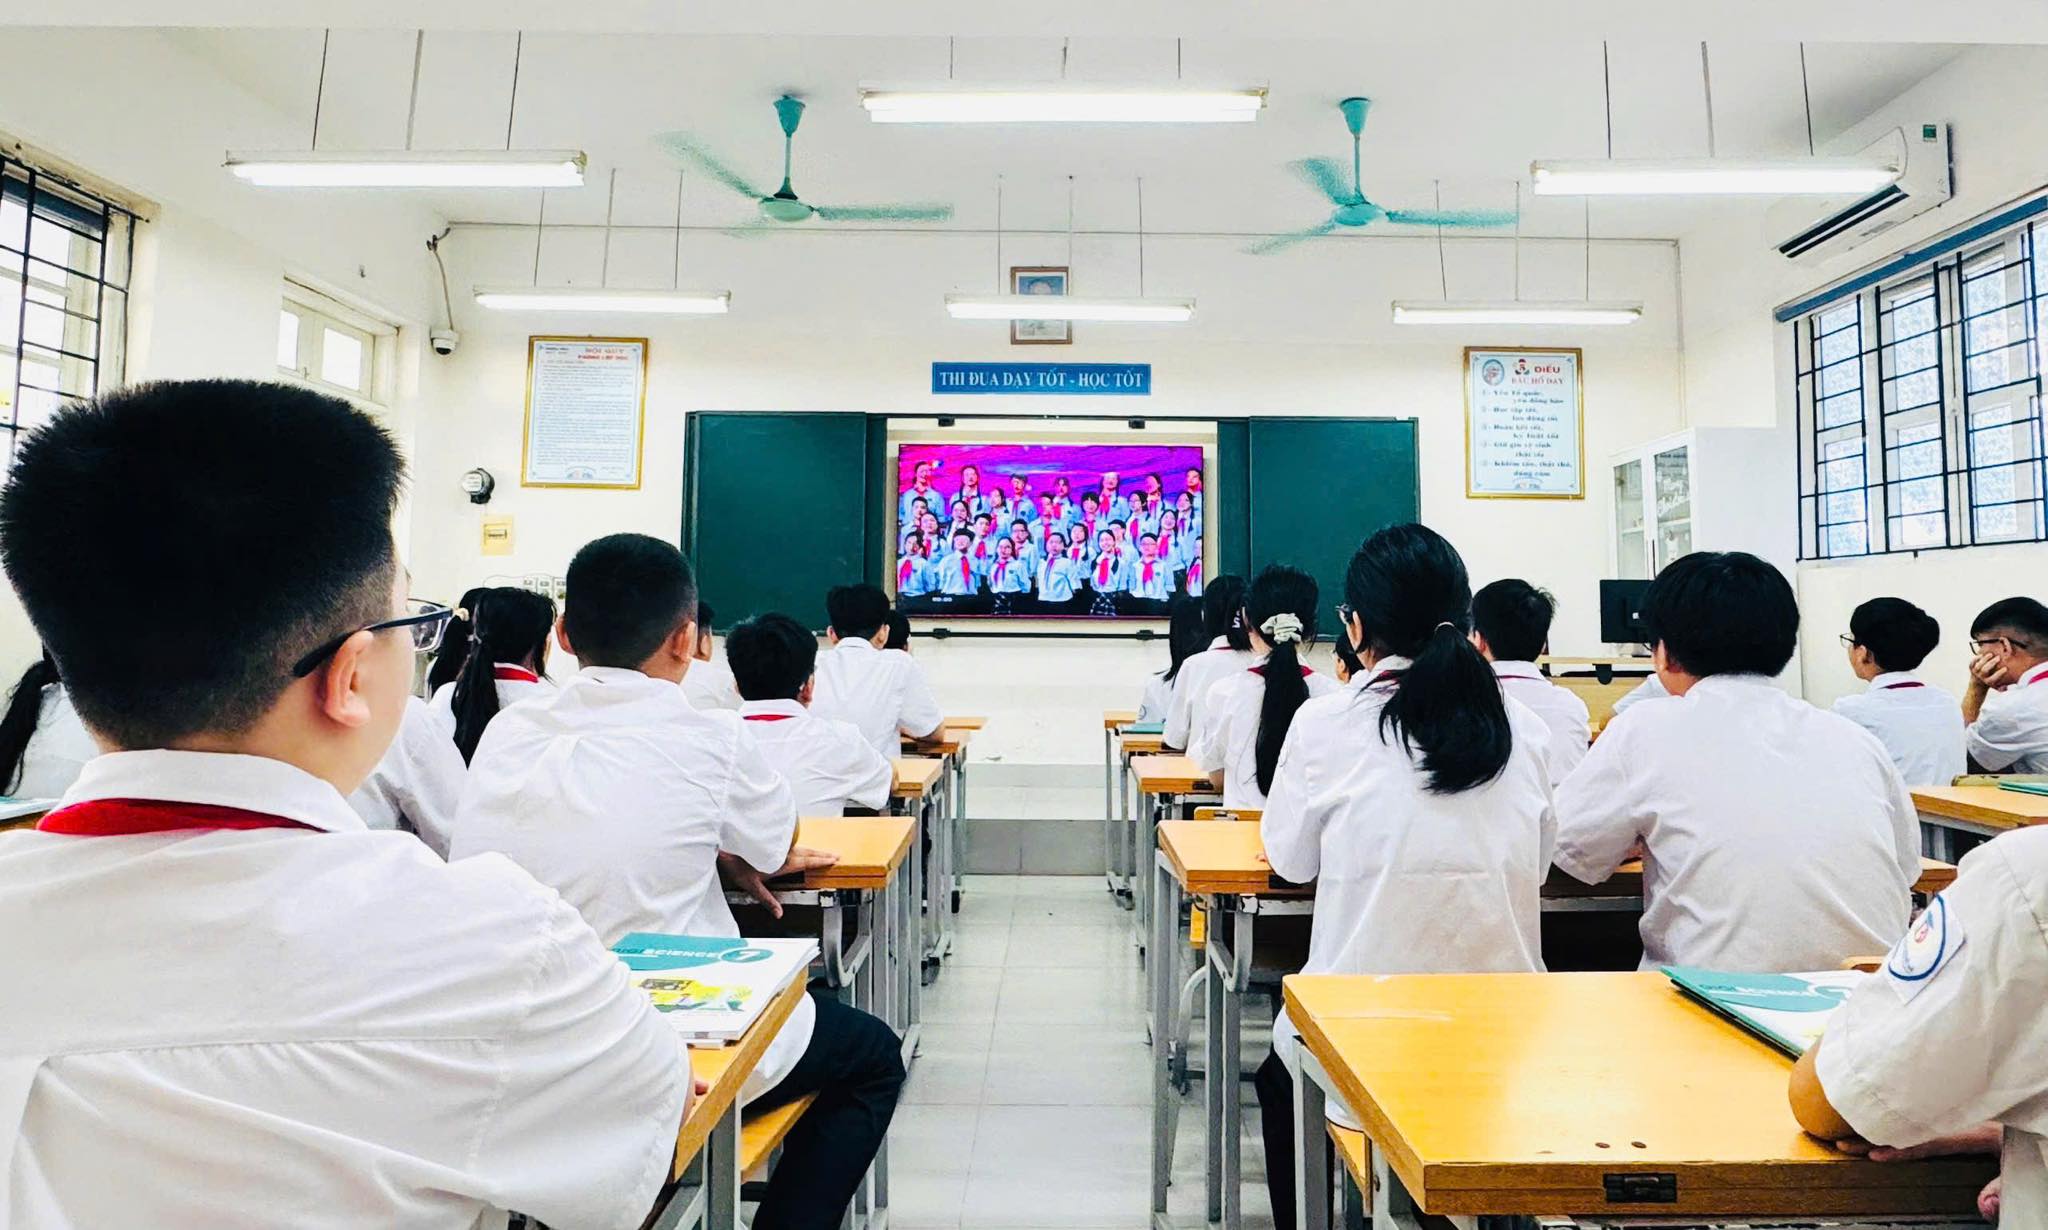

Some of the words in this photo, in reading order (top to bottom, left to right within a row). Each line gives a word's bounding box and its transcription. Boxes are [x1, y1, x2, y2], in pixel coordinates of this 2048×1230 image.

[939, 371, 965, 386] THI
[968, 371, 1000, 386] ĐUA
[1003, 371, 1033, 389] DẠY
[1036, 367, 1067, 387] TỐT
[1079, 372, 1110, 390] HỌC
[1113, 369, 1144, 388] TỐT
[738, 951, 759, 960] 7
